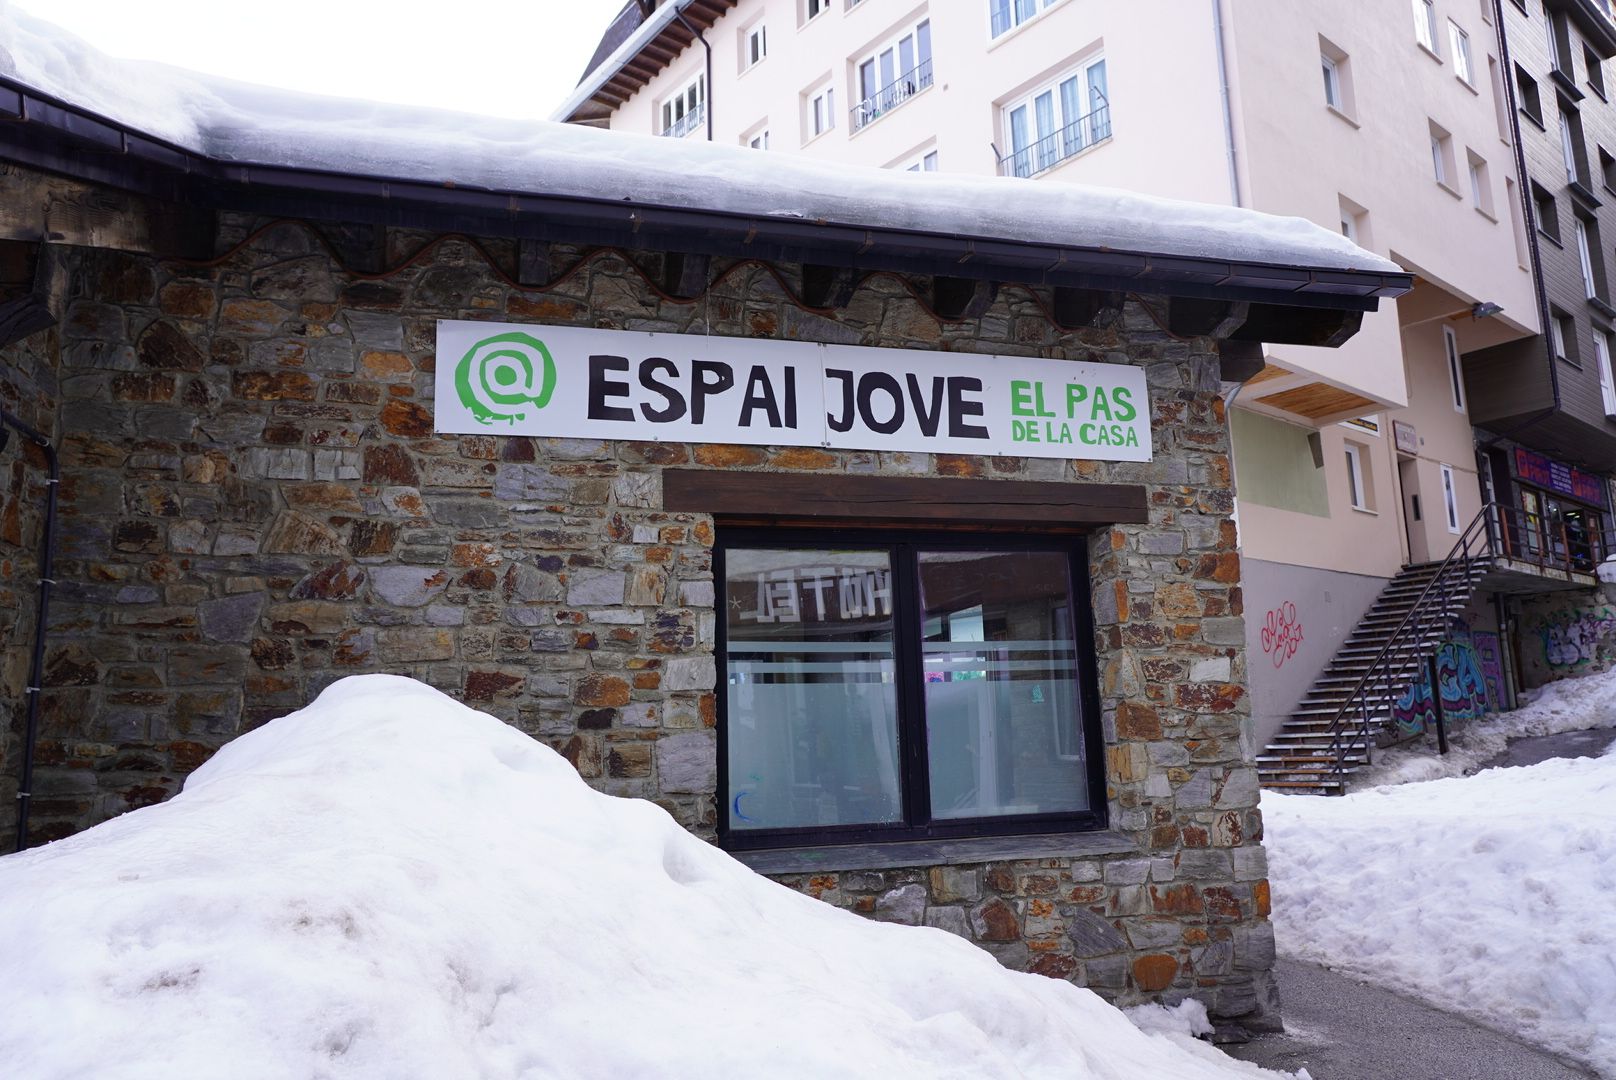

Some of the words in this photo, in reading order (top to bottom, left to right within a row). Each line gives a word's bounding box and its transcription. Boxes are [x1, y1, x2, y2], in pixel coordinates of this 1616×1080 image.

[587, 354, 798, 430] ESPAI
[825, 367, 990, 440] JOVE
[1010, 380, 1056, 418] EL
[1066, 383, 1137, 422] PAS
[1011, 420, 1041, 443] DE
[1046, 421, 1073, 444] LA
[1079, 423, 1139, 448] CASA
